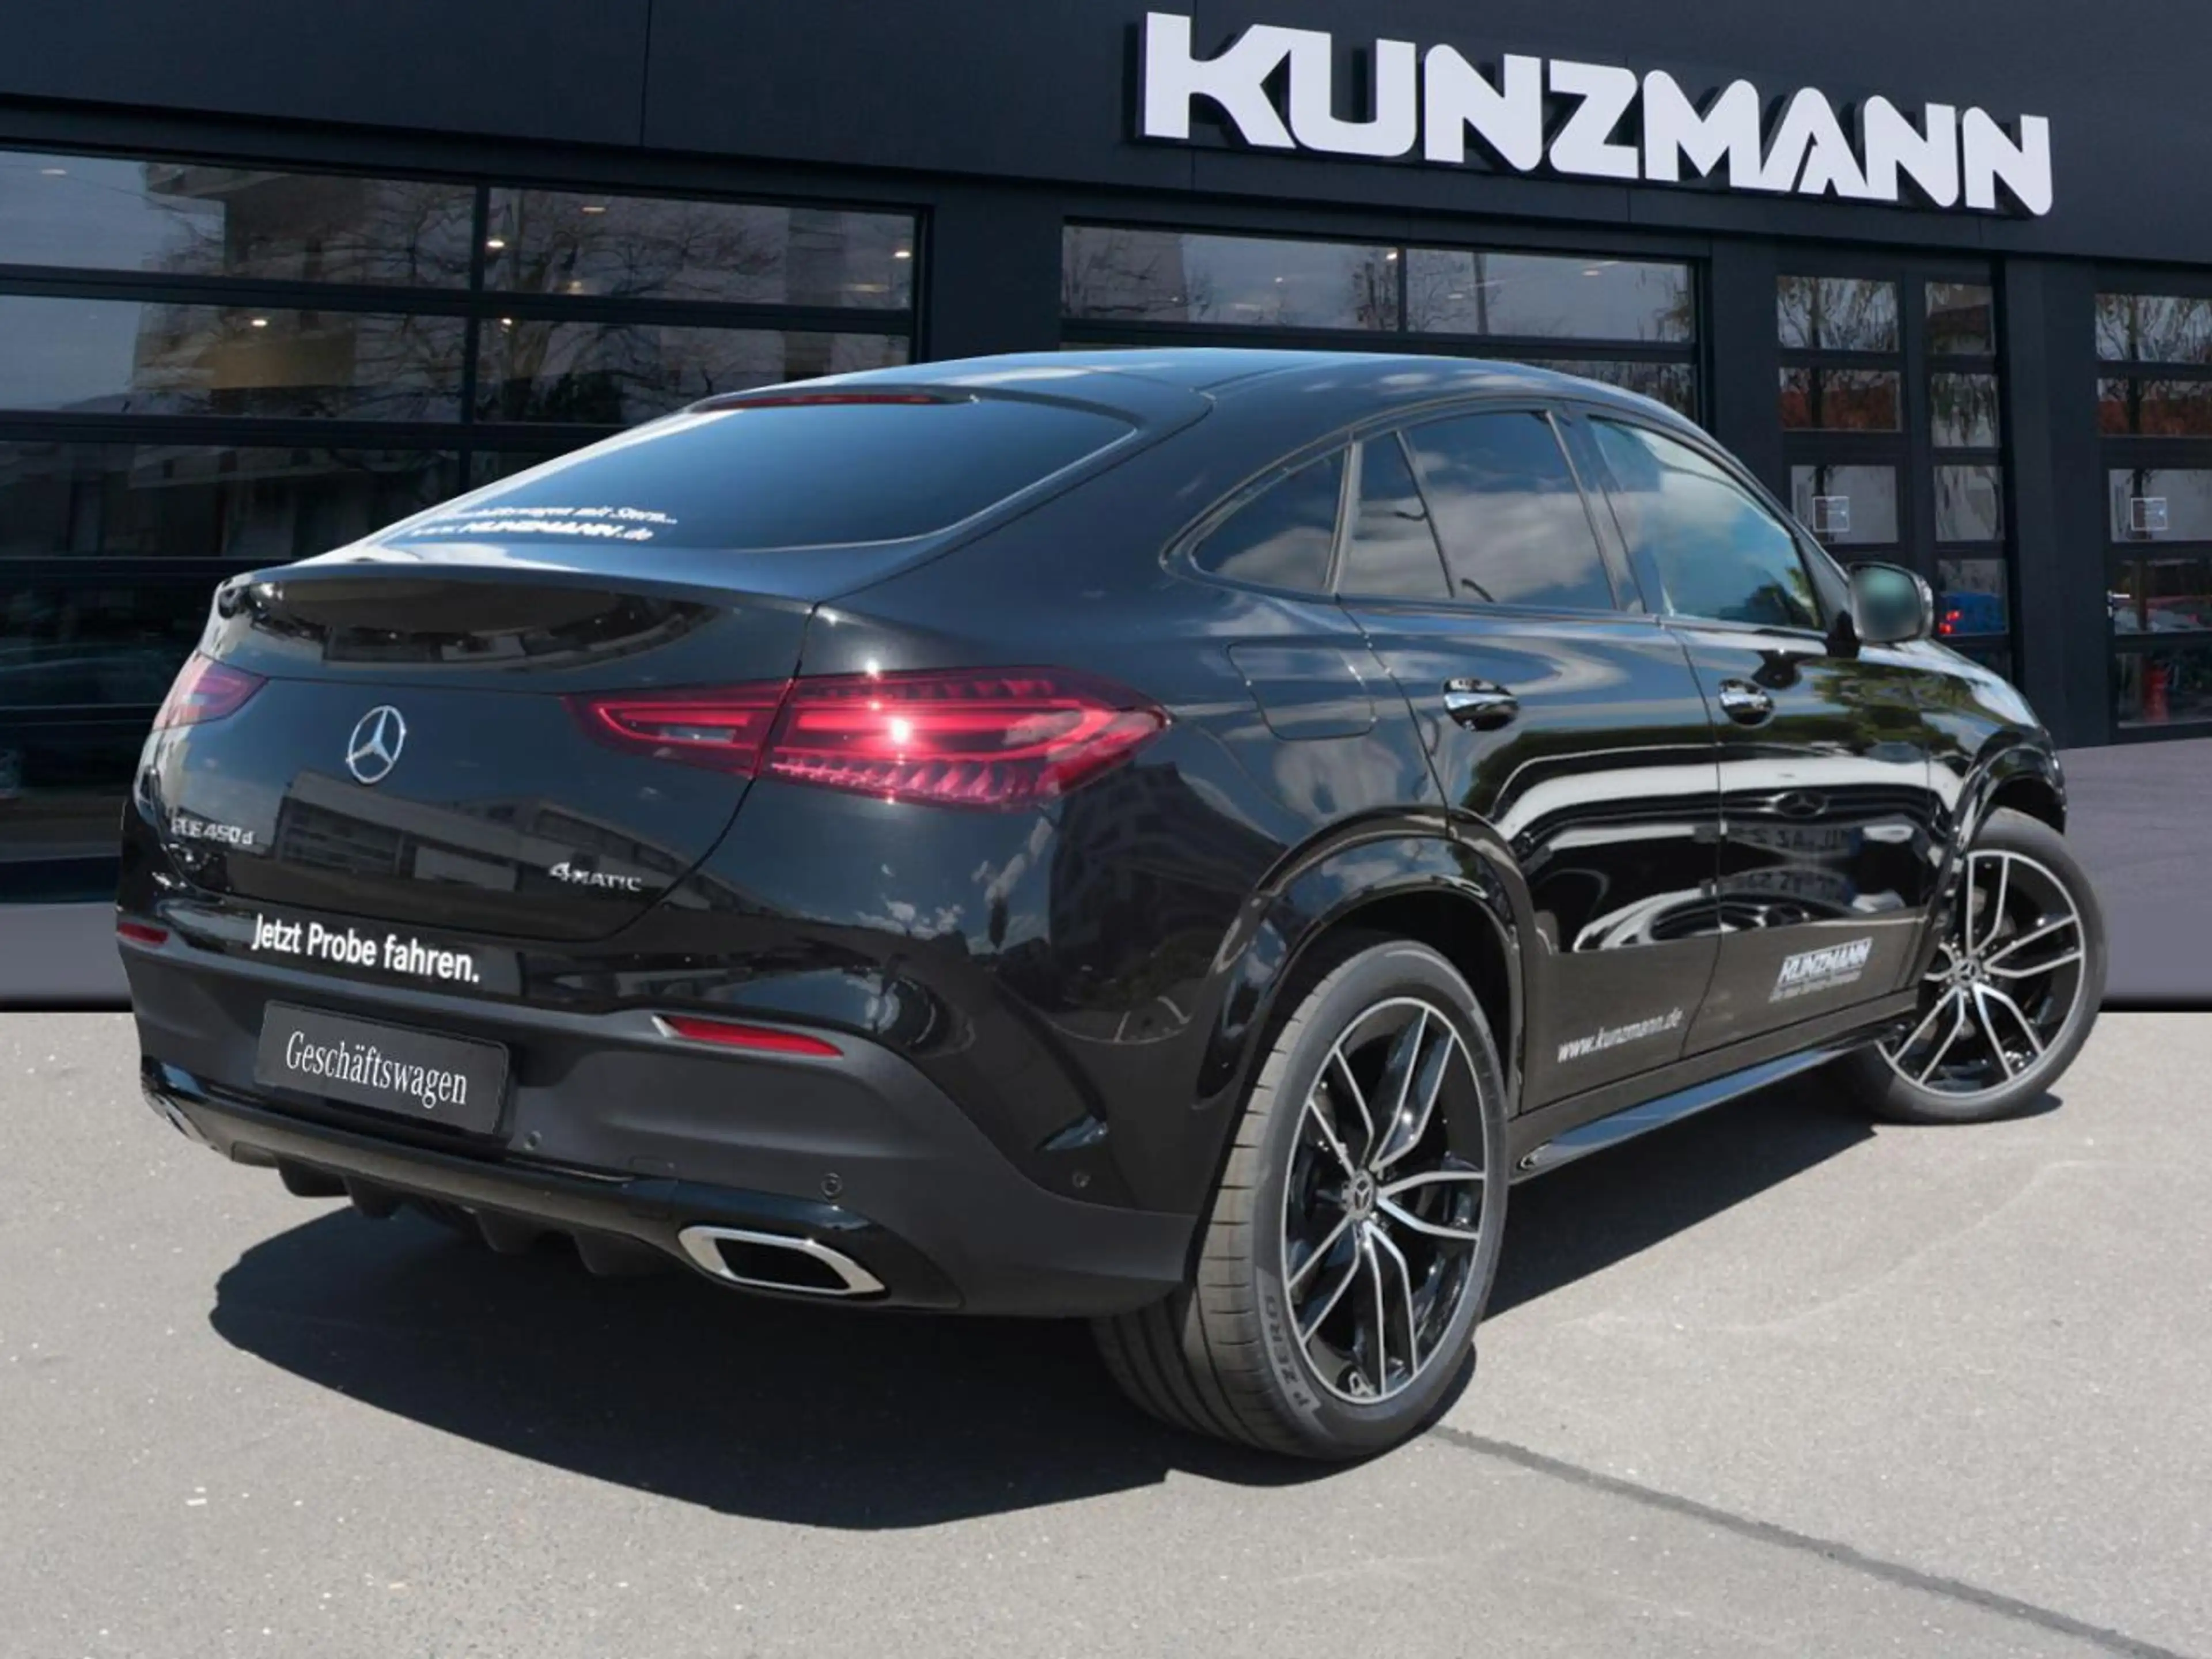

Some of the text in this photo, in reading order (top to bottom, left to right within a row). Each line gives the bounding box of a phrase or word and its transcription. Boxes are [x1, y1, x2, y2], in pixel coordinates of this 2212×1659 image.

[1145, 12, 2052, 215] KUNZMANN
[550, 862, 642, 891] 4MATIC
[251, 913, 480, 983] Jetzt Probe fahren.
[1777, 936, 1873, 987] KUNZMANN
[286, 1031, 468, 1109] Geschäftswagen
